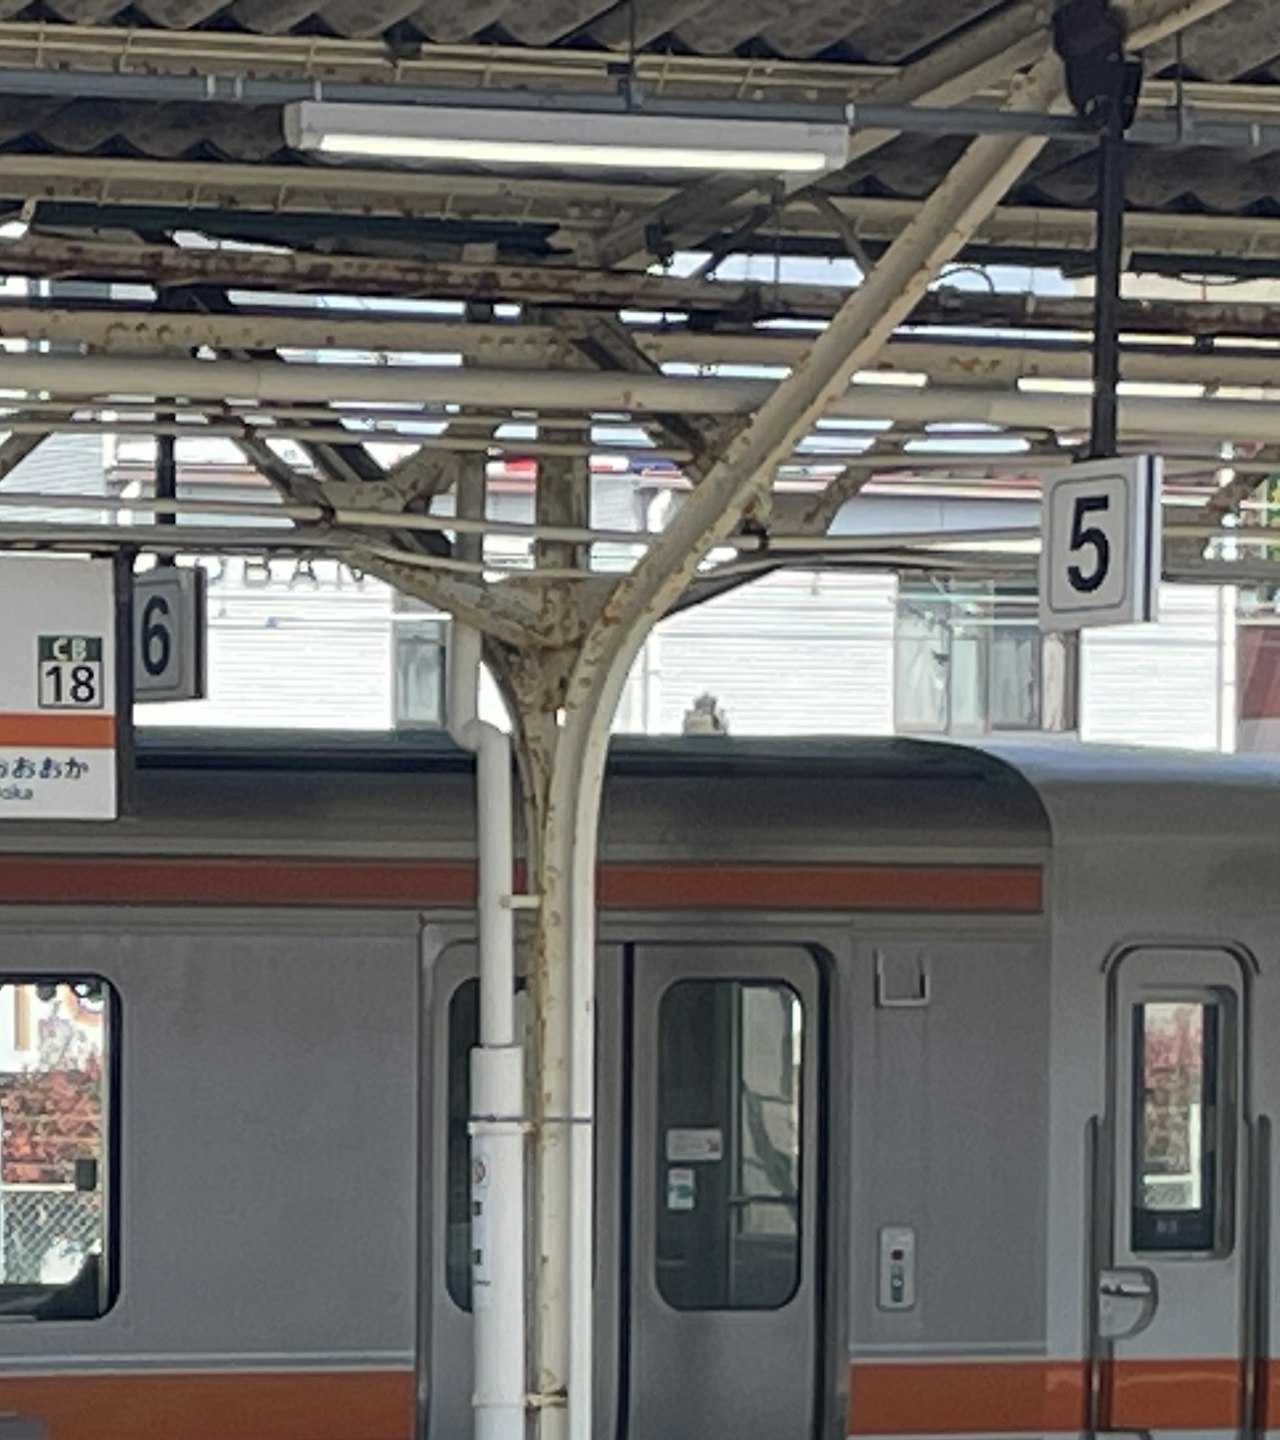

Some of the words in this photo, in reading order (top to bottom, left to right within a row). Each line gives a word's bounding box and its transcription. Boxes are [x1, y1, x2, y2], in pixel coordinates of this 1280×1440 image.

[1067, 495, 1109, 593] 5
[142, 595, 170, 676] 6
[46, 666, 95, 702] 18
